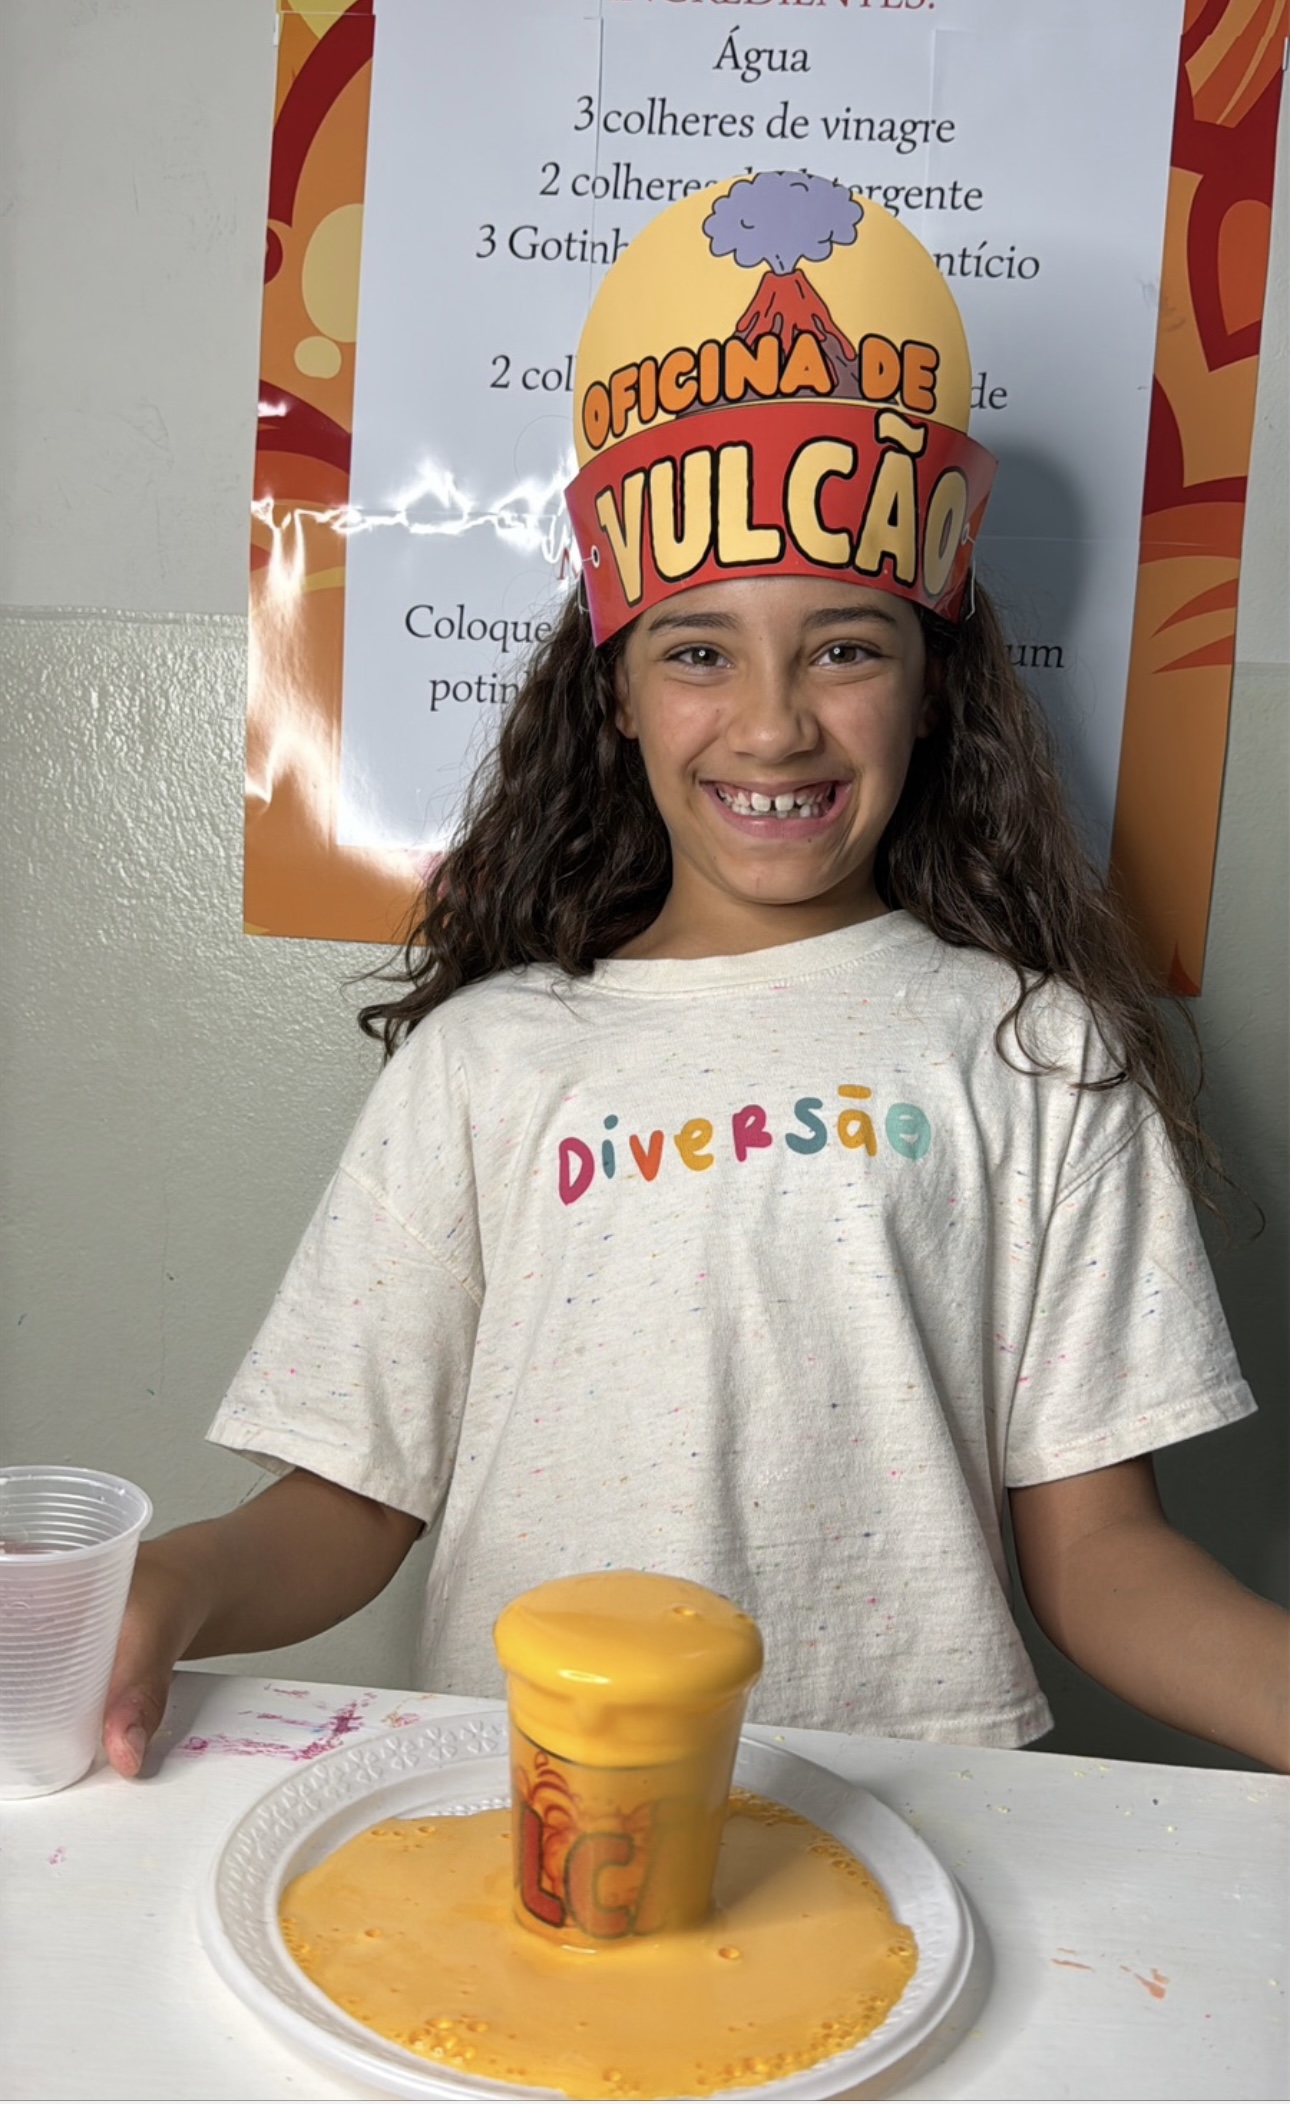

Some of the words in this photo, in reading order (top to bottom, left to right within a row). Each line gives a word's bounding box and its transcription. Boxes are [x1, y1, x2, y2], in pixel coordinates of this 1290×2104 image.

[712, 25, 811, 83] Água
[574, 95, 594, 132] 3
[602, 97, 754, 137] colheres
[766, 101, 809, 140] de
[821, 107, 956, 154] vinagre
[539, 161, 560, 197] 2
[475, 224, 497, 259] 3
[508, 224, 629, 264] Gotinh
[933, 240, 1041, 280] ntício
[490, 354, 511, 389] 2
[521, 354, 576, 392] col
[969, 372, 1008, 410] de
[581, 330, 837, 451] OFICINA
[858, 333, 940, 415] DE
[595, 410, 970, 608] VULCÃO
[405, 603, 553, 654] Coloque
[1005, 644, 1065, 669] um
[429, 671, 532, 713] potin
